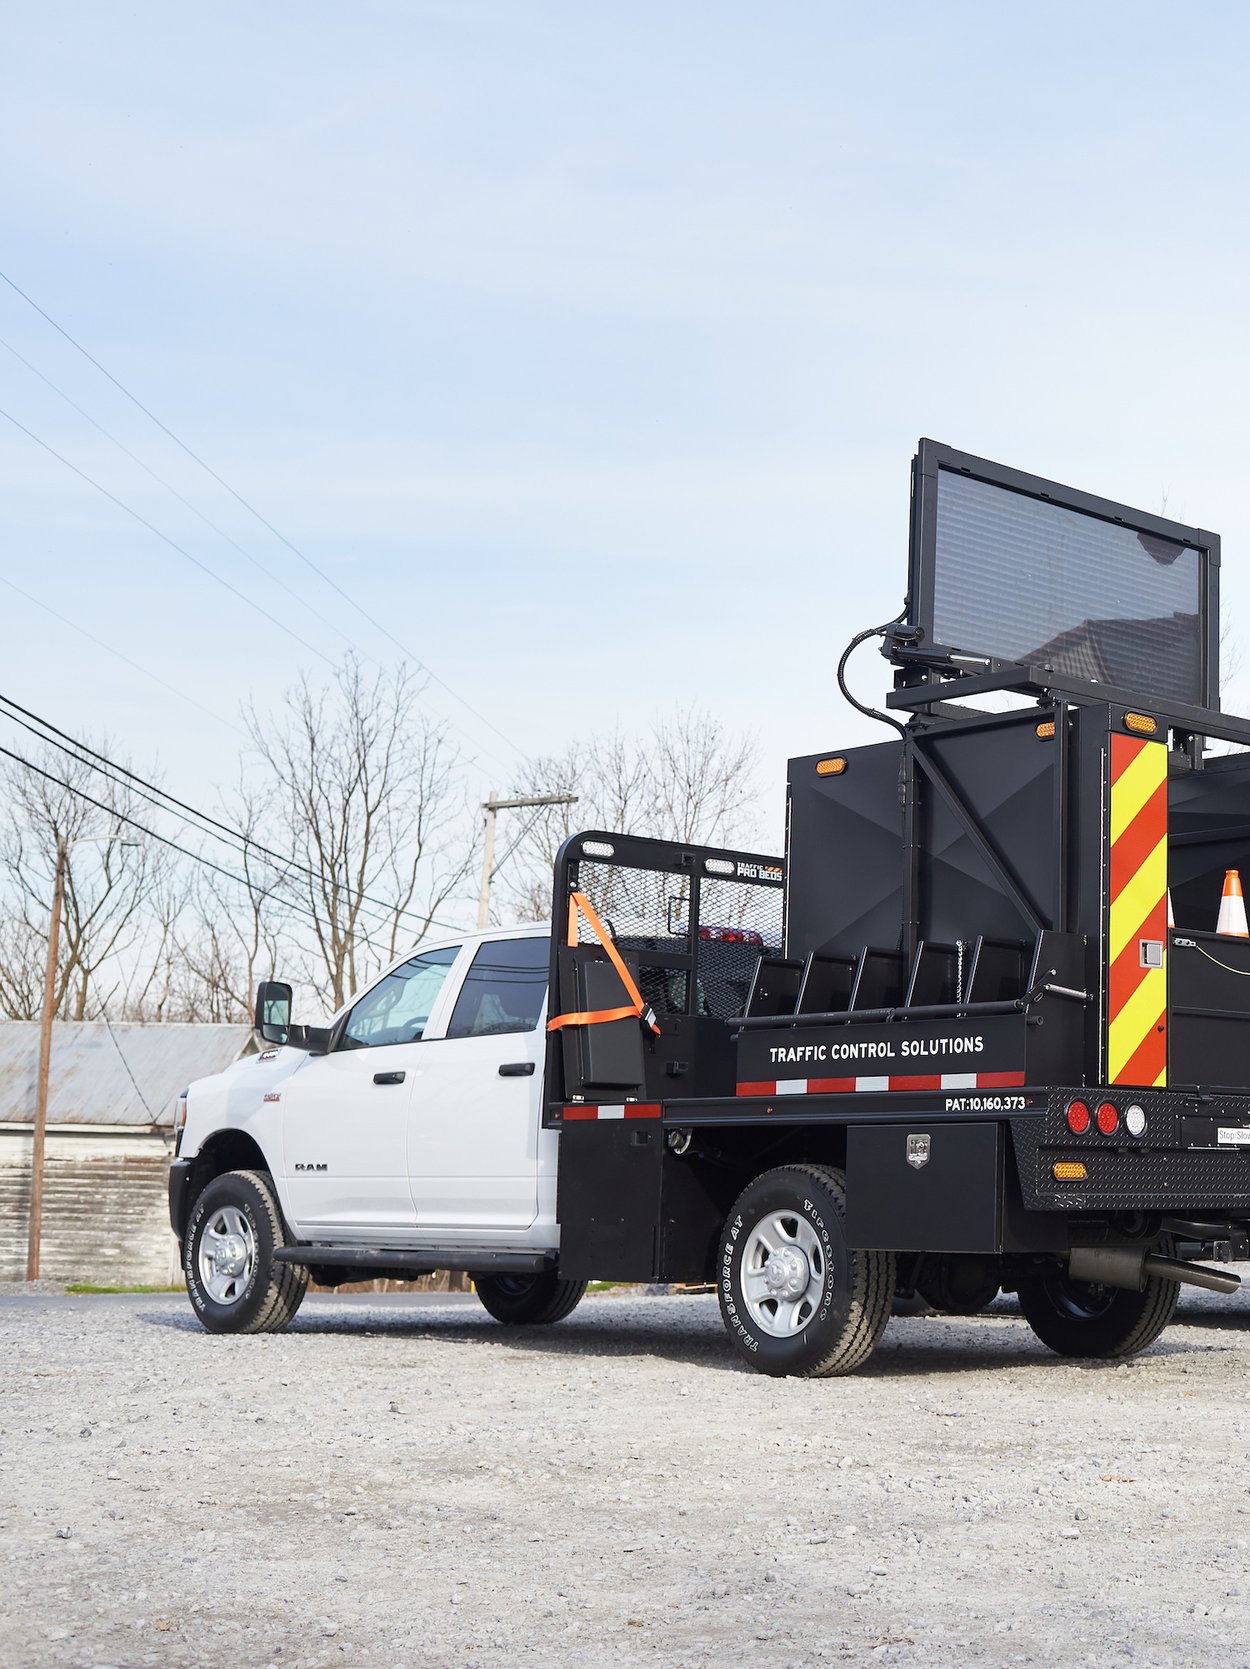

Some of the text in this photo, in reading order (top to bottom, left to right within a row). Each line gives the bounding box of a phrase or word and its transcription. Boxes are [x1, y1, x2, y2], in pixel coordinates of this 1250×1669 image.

[737, 867, 783, 881] PRO BEDS
[770, 1036, 984, 1063] TRAFFIC CONTROL SOLUTIONS
[945, 1096, 1026, 1112] PAT:10,160,373
[295, 1163, 329, 1172] RAM
[722, 1215, 760, 1352] TRANSFORCE AT
